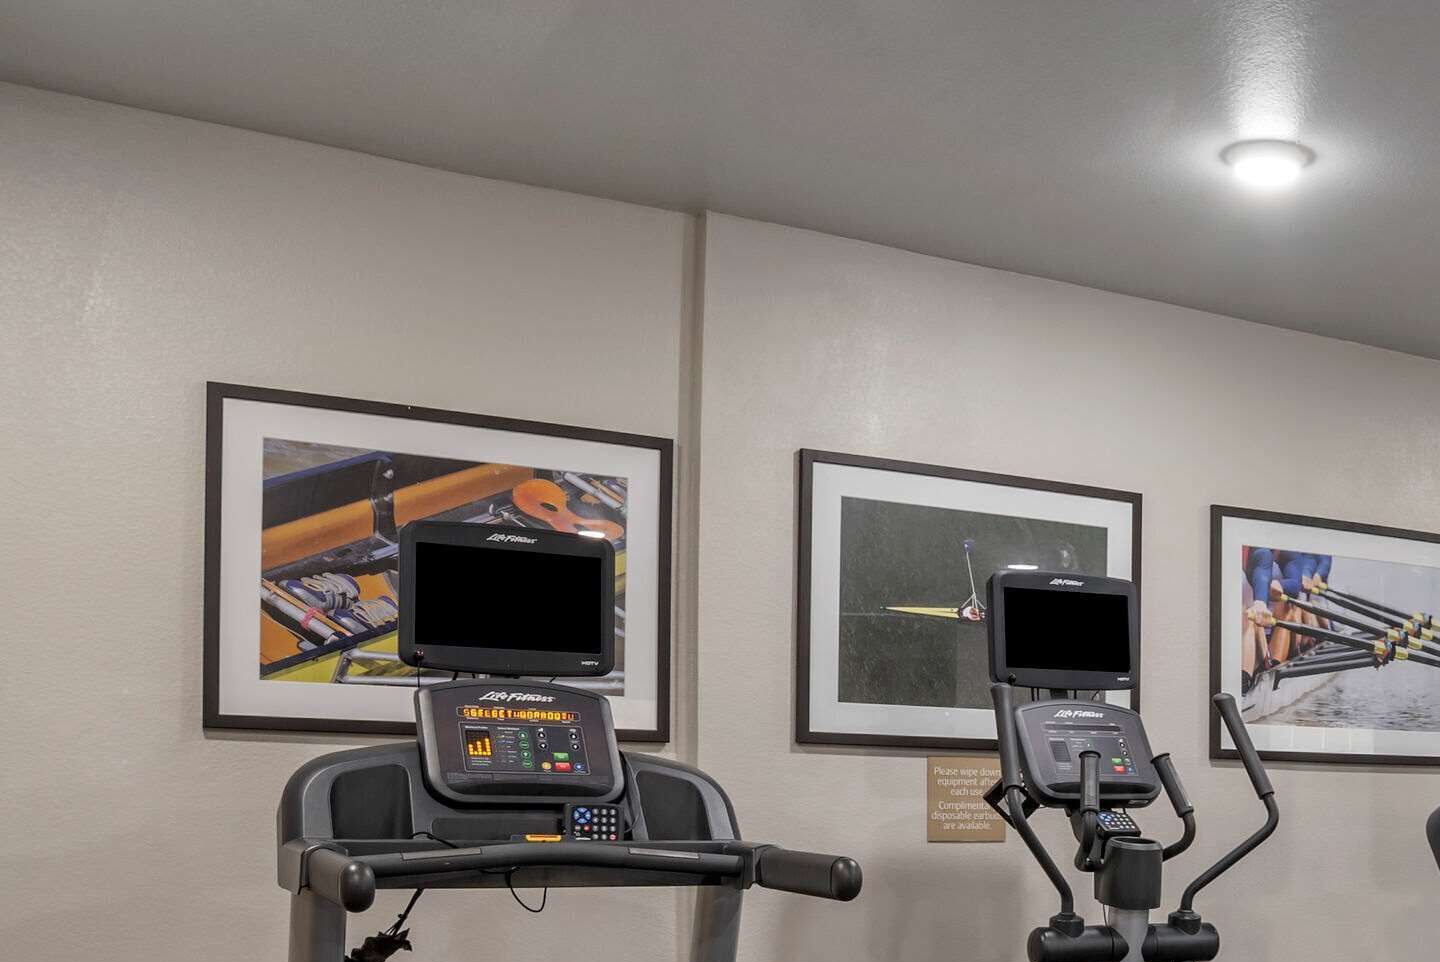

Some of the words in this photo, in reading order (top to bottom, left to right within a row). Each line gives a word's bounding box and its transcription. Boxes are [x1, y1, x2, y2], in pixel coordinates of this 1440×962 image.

[479, 690, 508, 701] Life
[506, 692, 554, 702] Fitness
[934, 767, 958, 776] Please
[959, 767, 978, 777] wipe
[937, 778, 978, 788] equipment
[951, 787, 969, 796] each
[931, 811, 972, 821] disposable
